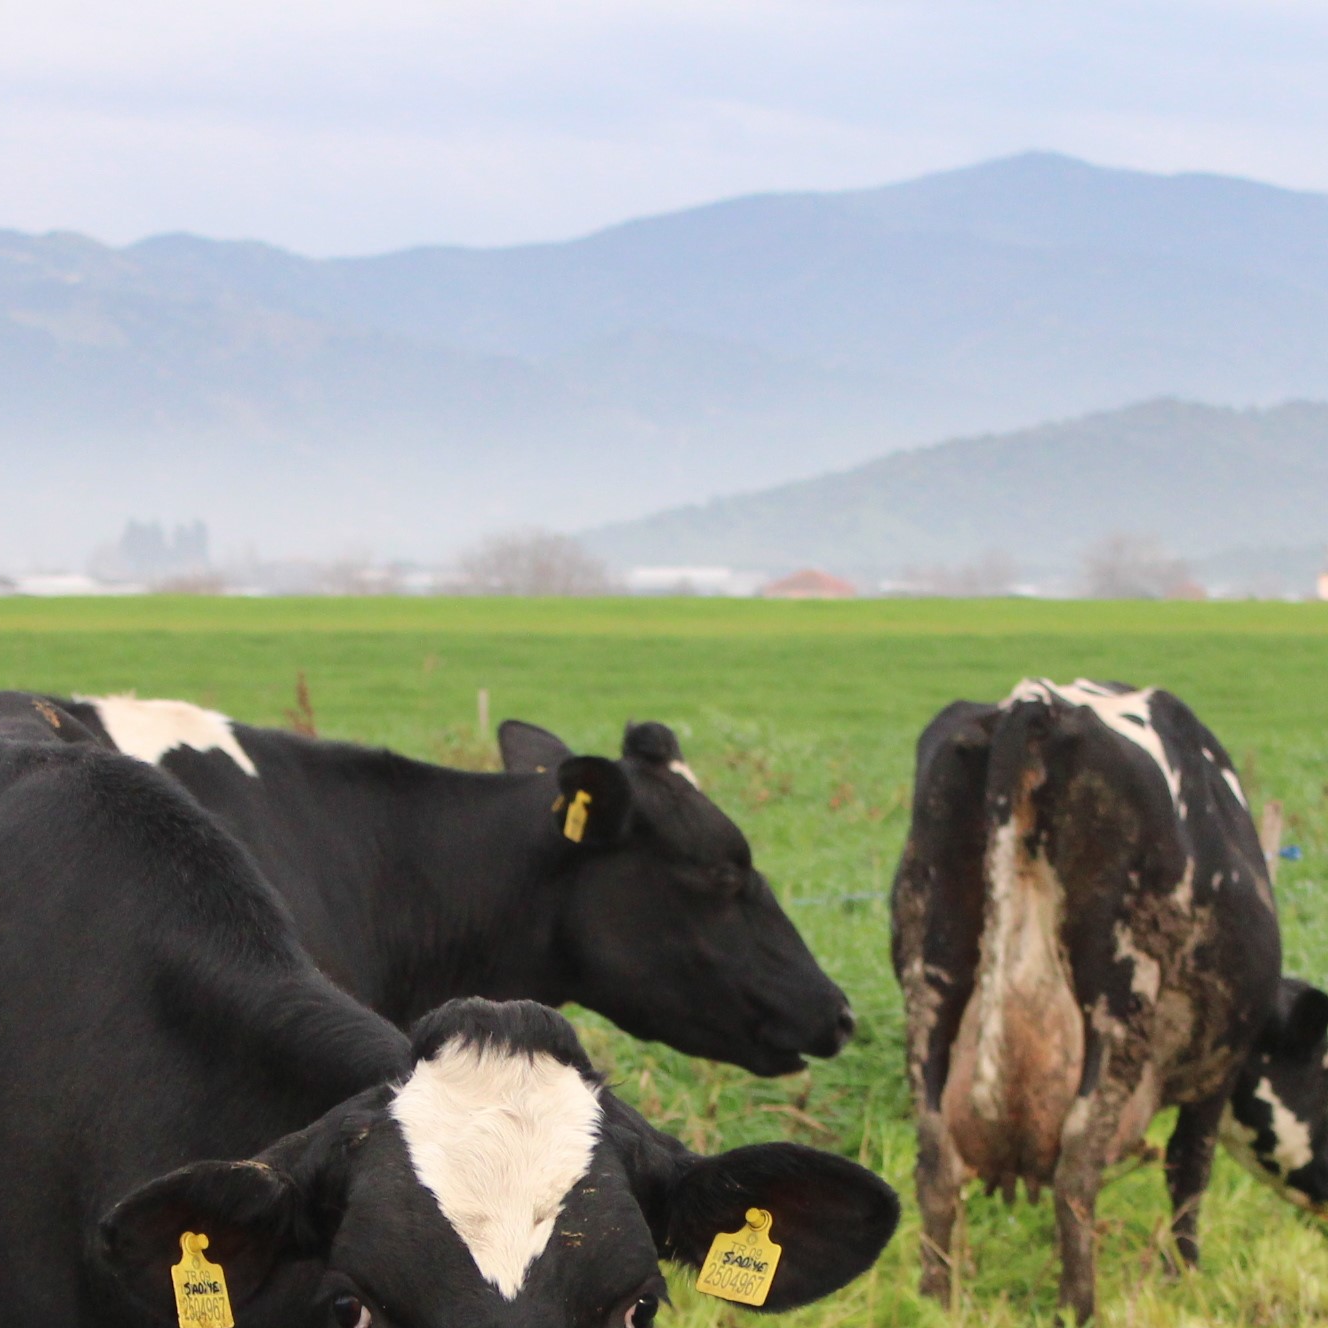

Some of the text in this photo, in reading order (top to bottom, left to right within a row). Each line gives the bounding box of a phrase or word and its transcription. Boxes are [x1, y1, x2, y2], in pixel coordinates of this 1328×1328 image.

[184, 1270, 198, 1282] TR
[703, 1262, 766, 1298] 2504967
[182, 1296, 226, 1321] 2504967
